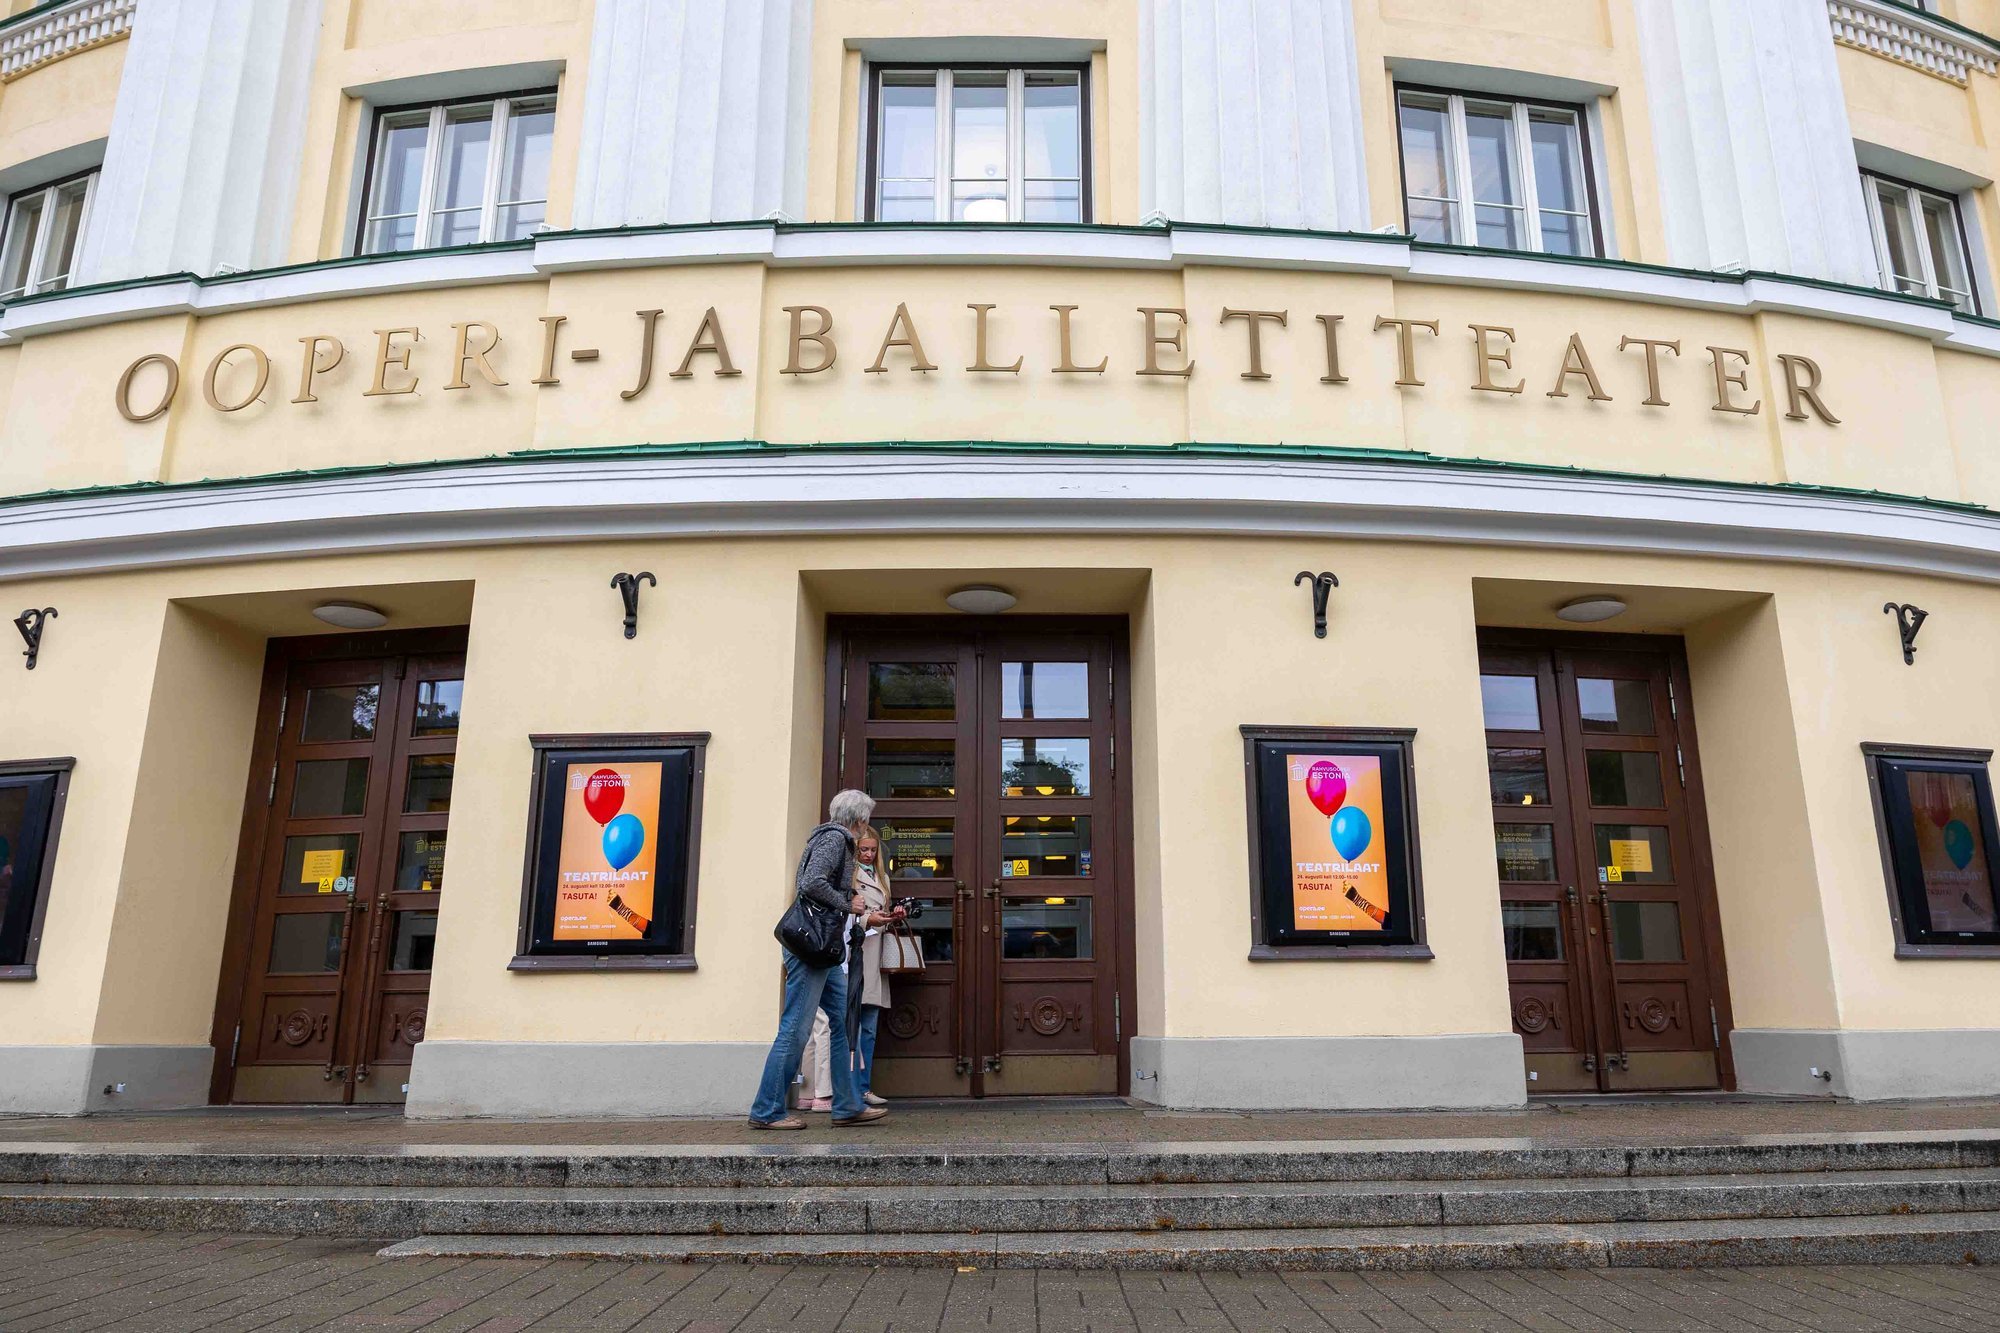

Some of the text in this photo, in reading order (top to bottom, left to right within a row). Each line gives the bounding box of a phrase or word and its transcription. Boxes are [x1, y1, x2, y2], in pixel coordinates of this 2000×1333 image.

[779, 301, 1842, 425] BALLETITEATER
[1296, 863, 1381, 873] TEATRILAAT
[563, 871, 649, 882] TEATRILAAT
[1298, 883, 1333, 891] TASUTA!
[562, 892, 598, 901] TASUTA!
